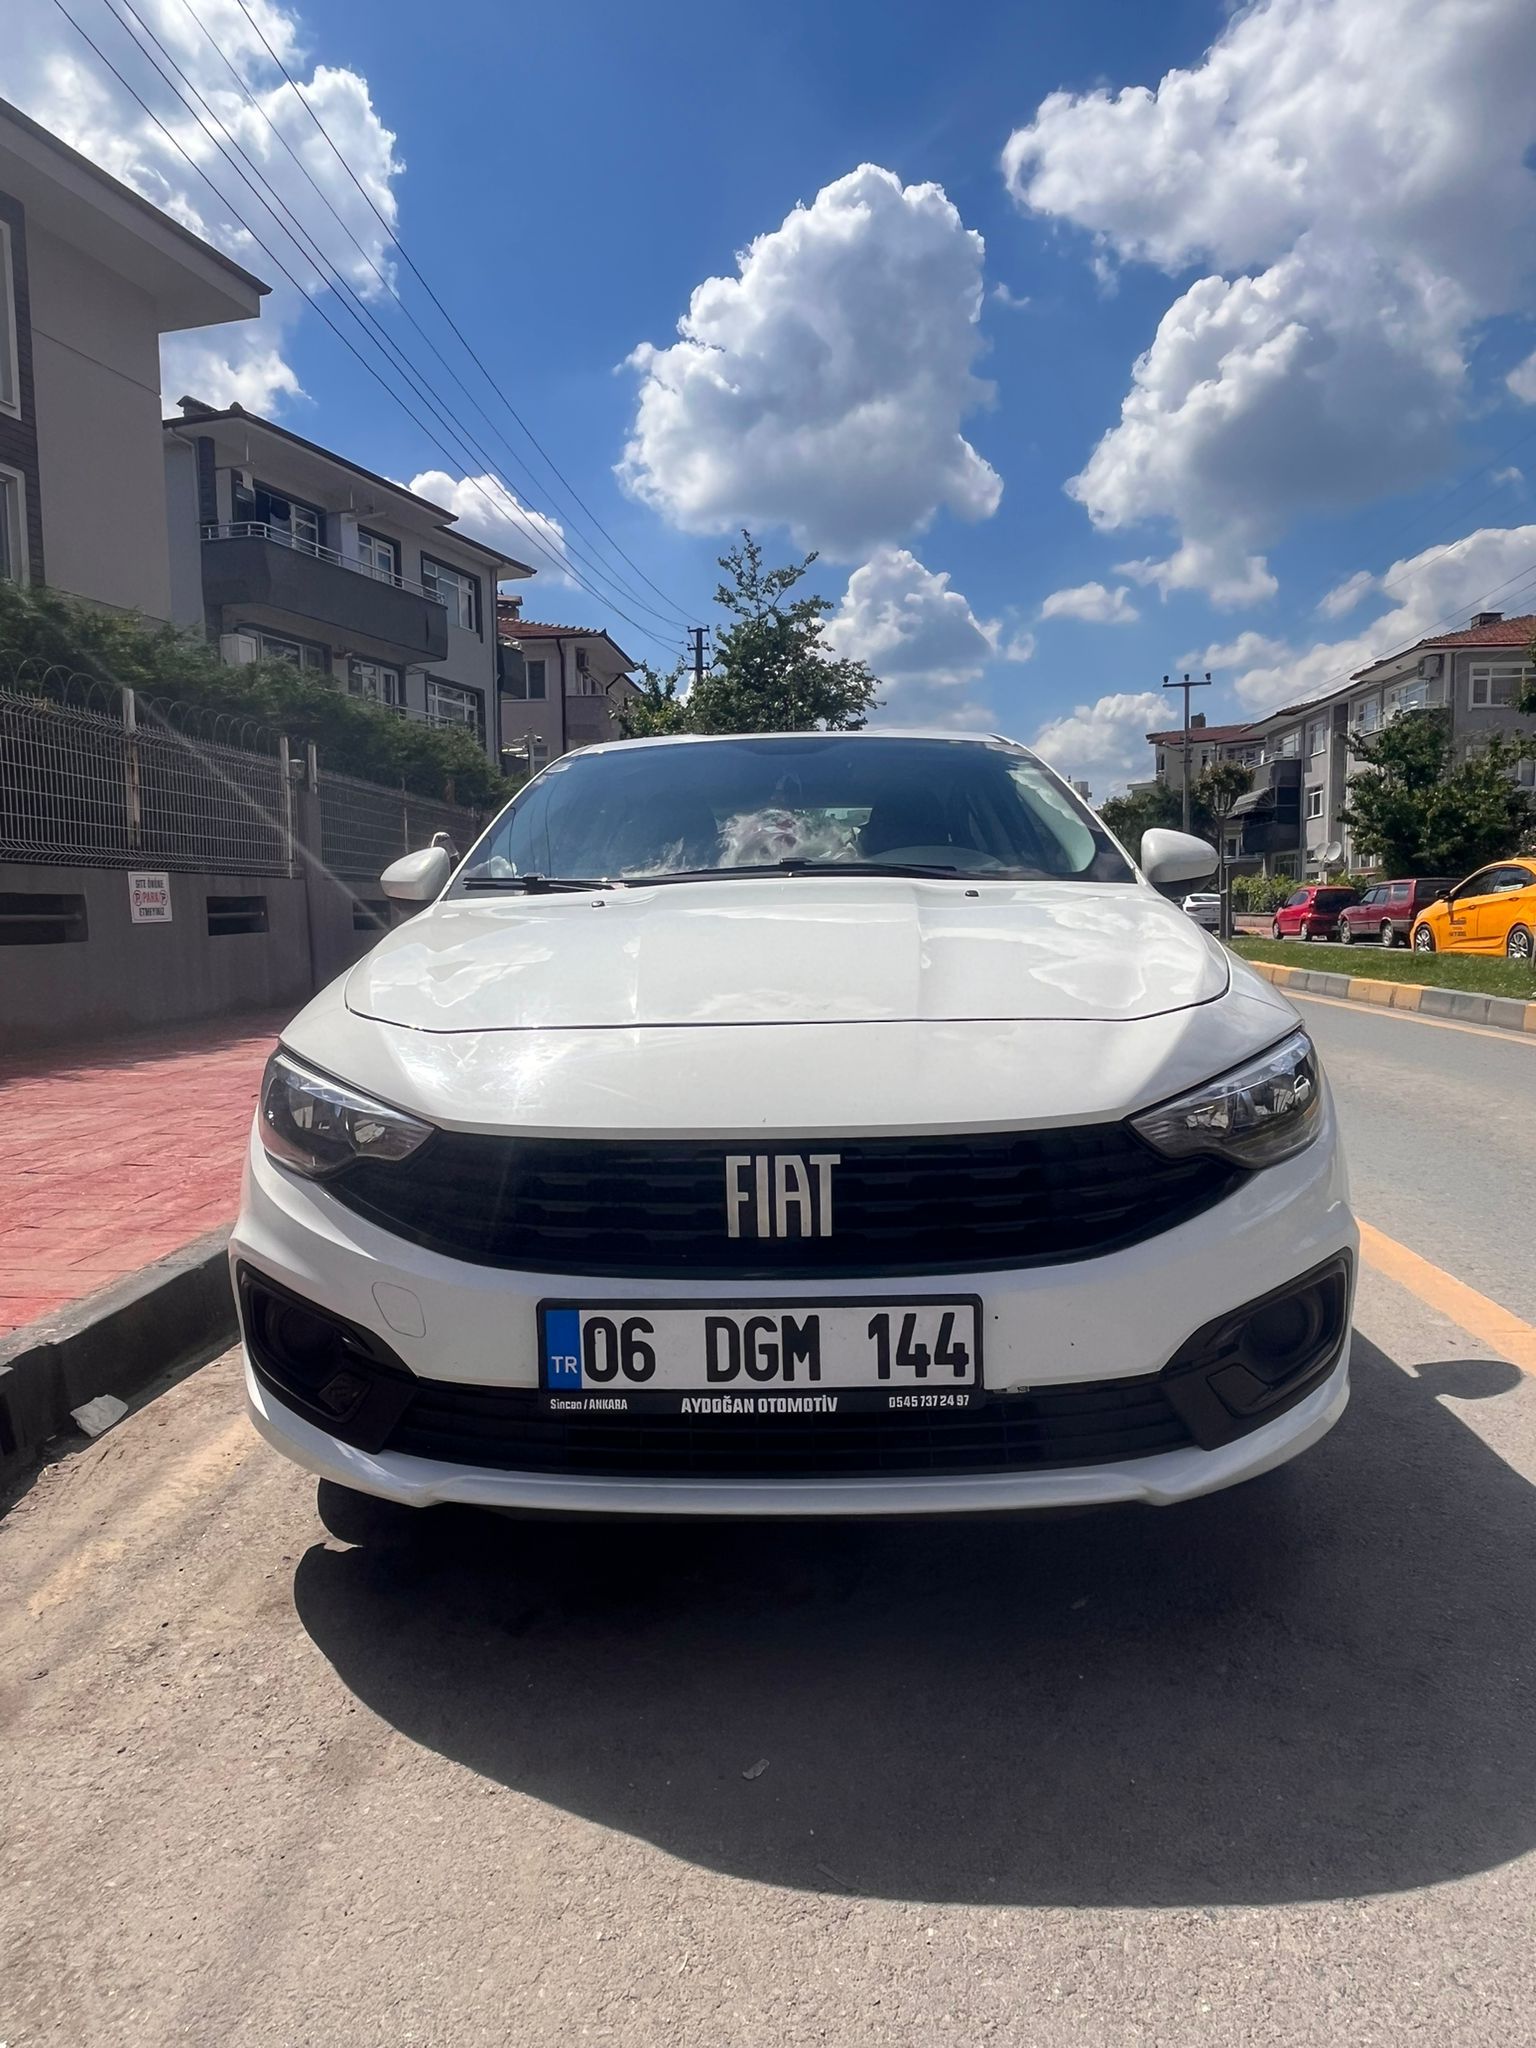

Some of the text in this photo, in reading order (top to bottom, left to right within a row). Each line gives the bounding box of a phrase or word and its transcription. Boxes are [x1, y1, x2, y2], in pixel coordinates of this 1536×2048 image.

[726, 1154, 841, 1237] FIAT
[551, 1312, 969, 1382] TR 06 DGM 144
[681, 1394, 838, 1413] AYDOĞAN OTOMOTİV
